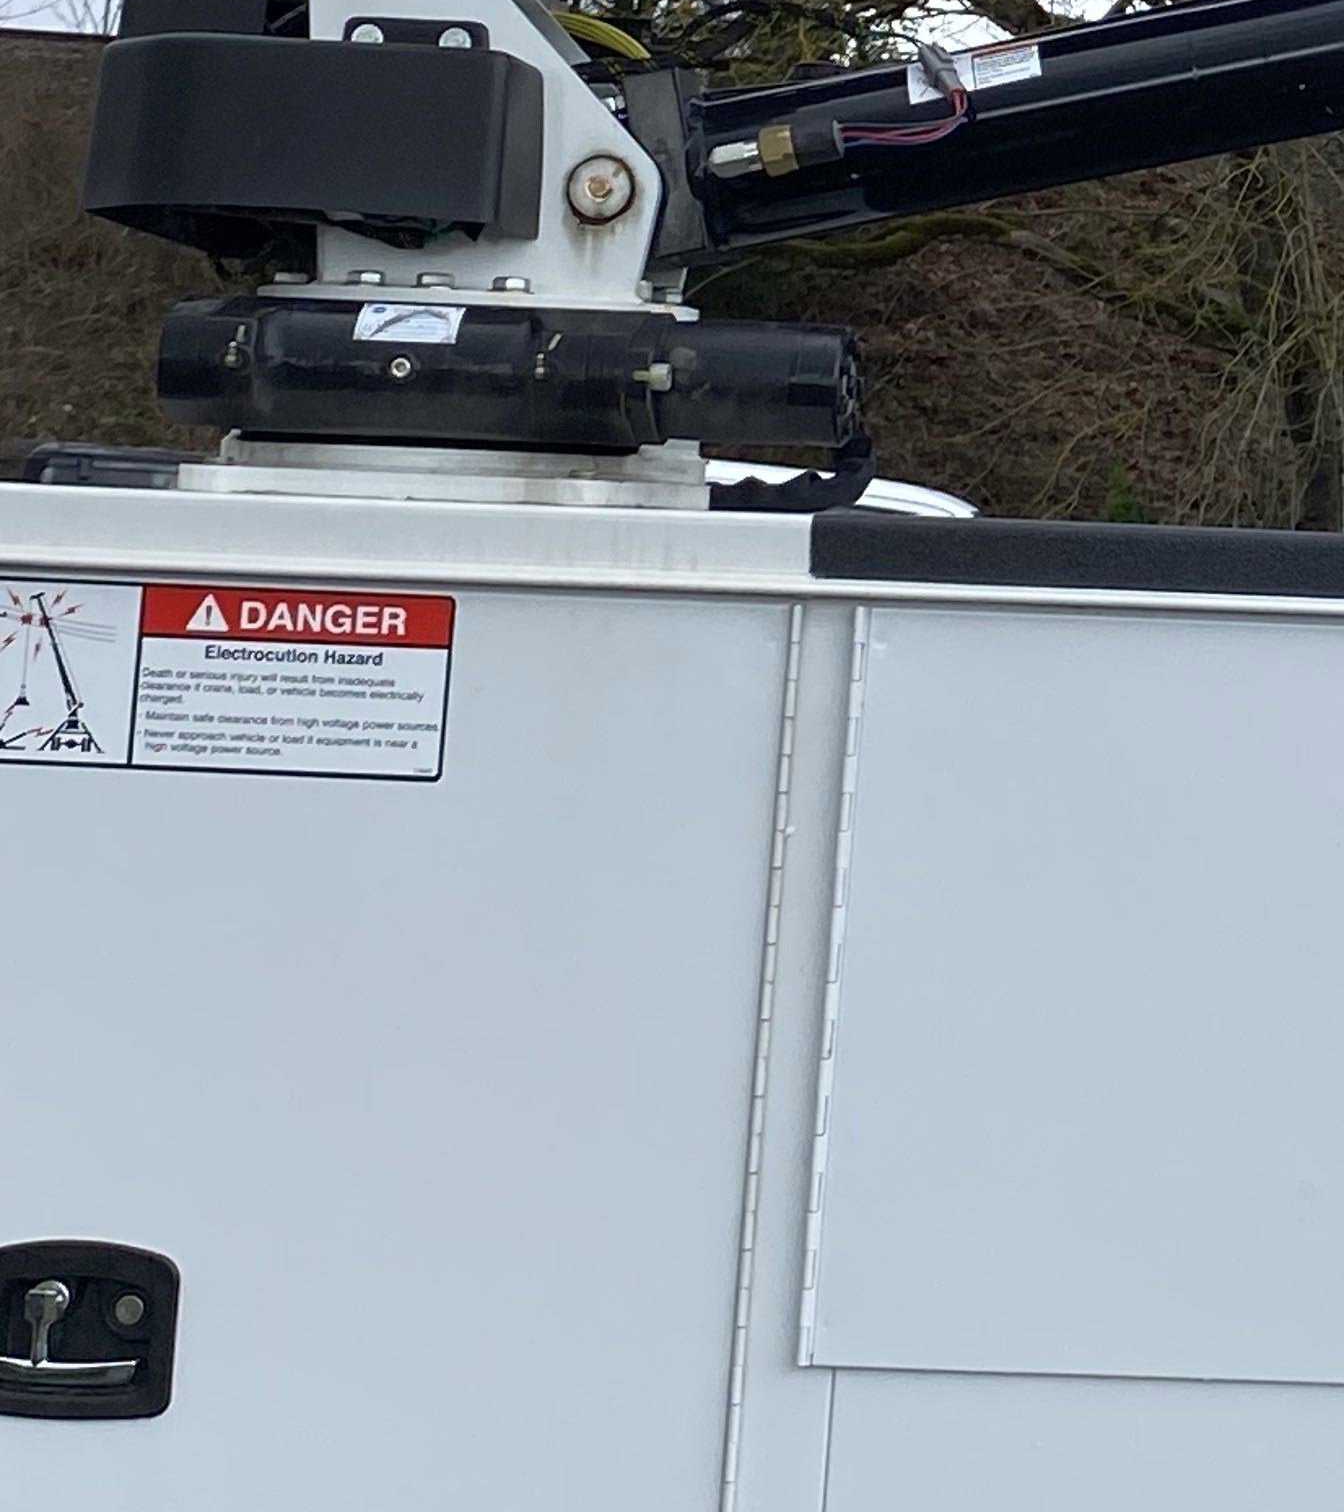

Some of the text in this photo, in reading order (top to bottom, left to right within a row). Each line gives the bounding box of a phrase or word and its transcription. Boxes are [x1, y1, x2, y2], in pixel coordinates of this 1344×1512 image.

[239, 600, 407, 636] DANGER
[204, 644, 384, 666] Electrocution Hazard
[312, 675, 334, 683] from
[320, 689, 366, 698] becomes
[369, 691, 424, 702] electrically
[145, 711, 189, 721] Maintain
[193, 713, 214, 722] safe
[218, 715, 267, 724] clearance
[297, 717, 319, 729] high
[322, 719, 359, 730] voltage
[362, 721, 394, 730] power
[178, 731, 226, 741] approach
[268, 735, 279, 743] or
[282, 735, 305, 744] load
[316, 737, 370, 747] equipment
[171, 743, 207, 755] voltage
[211, 745, 242, 755] power
